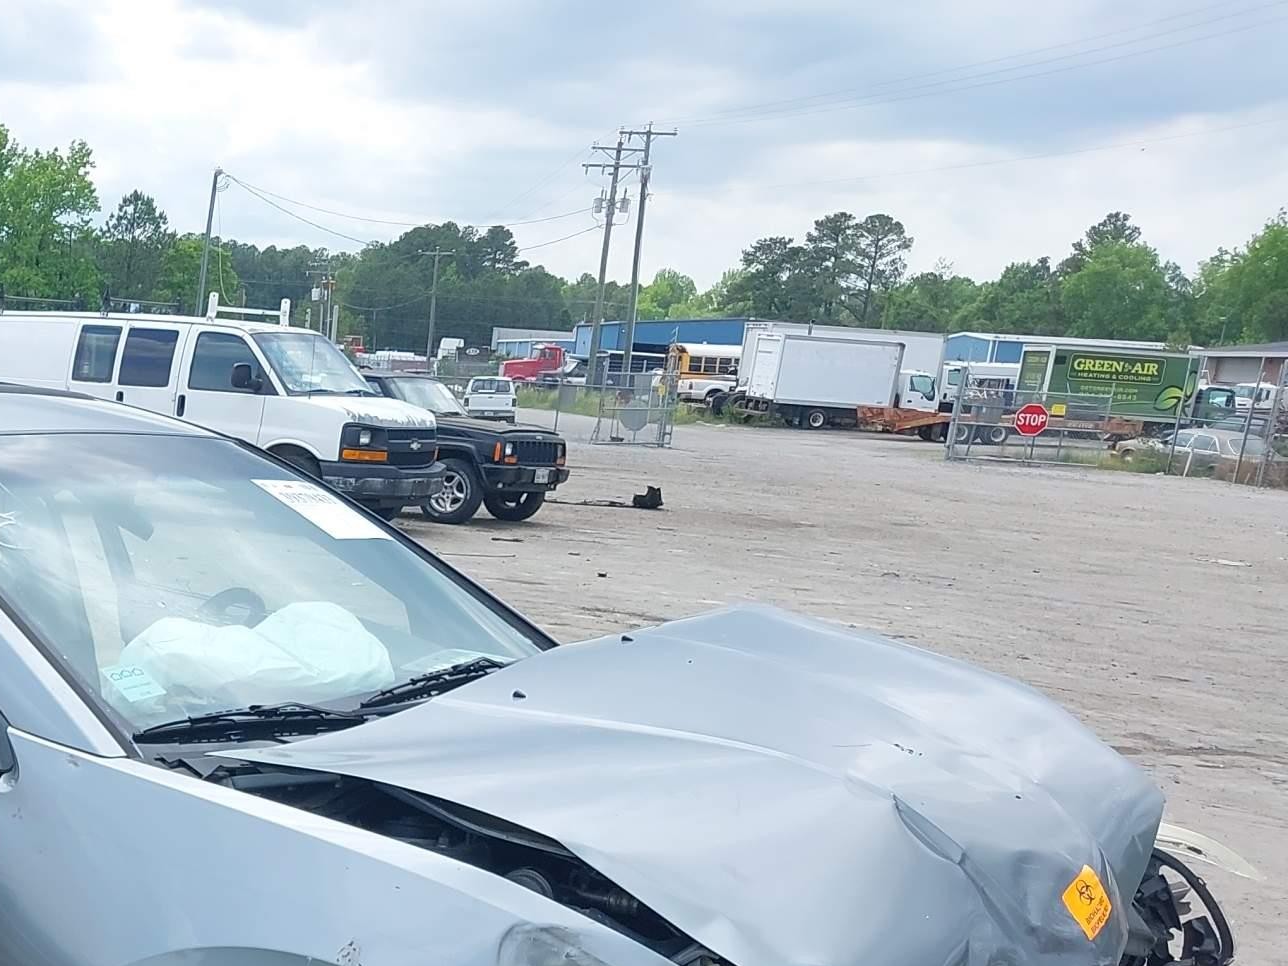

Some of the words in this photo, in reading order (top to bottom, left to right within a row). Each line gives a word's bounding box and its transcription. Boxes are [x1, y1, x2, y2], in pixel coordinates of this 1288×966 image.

[1073, 358, 1124, 373] GREEN
[1131, 362, 1159, 376] AIR
[1118, 374, 1152, 382] COOLING
[1017, 413, 1047, 427] STOP
